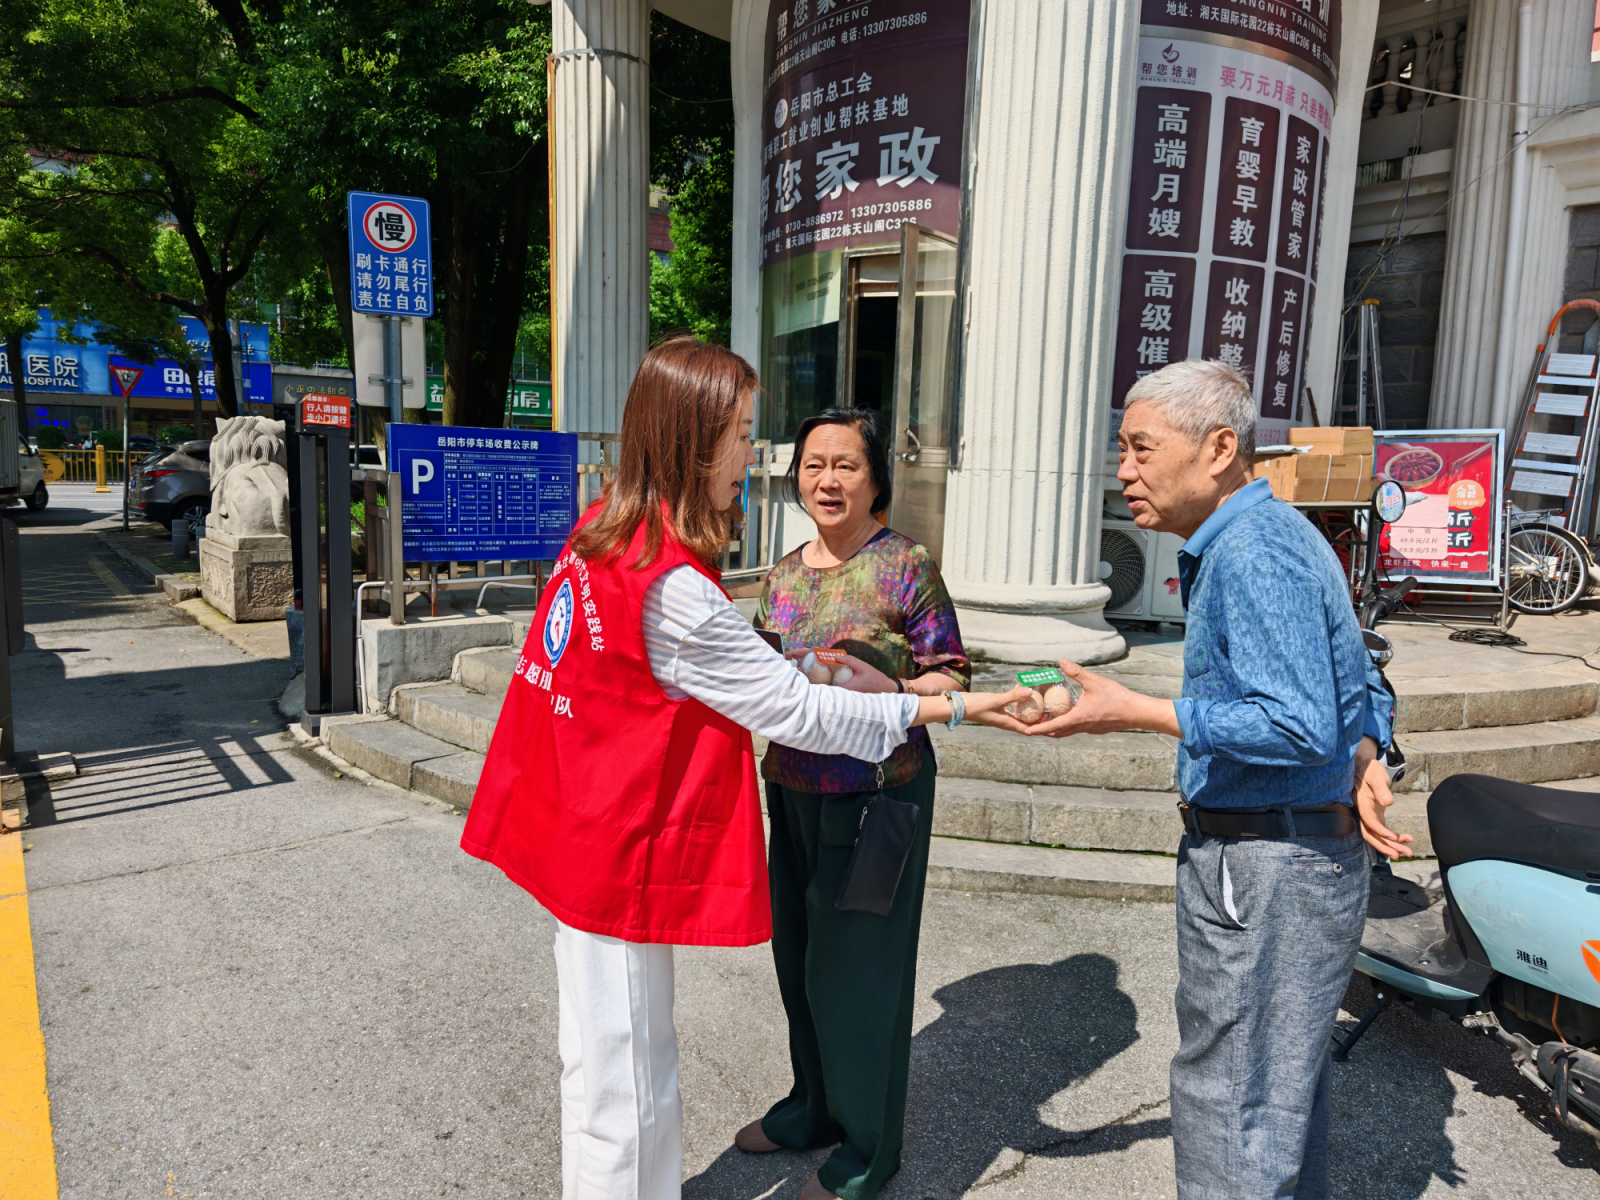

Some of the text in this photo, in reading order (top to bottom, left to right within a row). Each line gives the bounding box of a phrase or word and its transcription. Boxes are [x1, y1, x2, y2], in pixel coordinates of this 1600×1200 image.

[812, 6, 869, 36] JIAZHENG
[1292, 12, 1327, 43] TRAINING
[1141, 62, 1197, 79] 帮您培训
[791, 72, 873, 118] 岳阳市总工会
[1220, 65, 1296, 108] 要万元月薪
[1148, 103, 1190, 239] 高端月嫂
[1230, 116, 1265, 247] 育婴早教
[851, 198, 932, 218] 13307305886
[1287, 136, 1311, 259] 家政管家
[374, 211, 407, 244] 慢
[356, 253, 428, 276] 刷卡通行
[356, 272, 429, 295] 请勿尾行
[357, 290, 429, 312] 责任自负
[1272, 288, 1298, 408] 产后修复
[24, 376, 79, 387] HOSPITAL
[306, 403, 348, 415] 行人请按键
[306, 413, 348, 425] 走小门通行
[437, 436, 539, 451] 岳阳市停车场收费公示牌
[412, 458, 435, 494] P
[1384, 559, 1421, 567] 龙虾狂欢
[514, 655, 574, 719] 志愿服队
[1516, 949, 1549, 970] 雅迪
